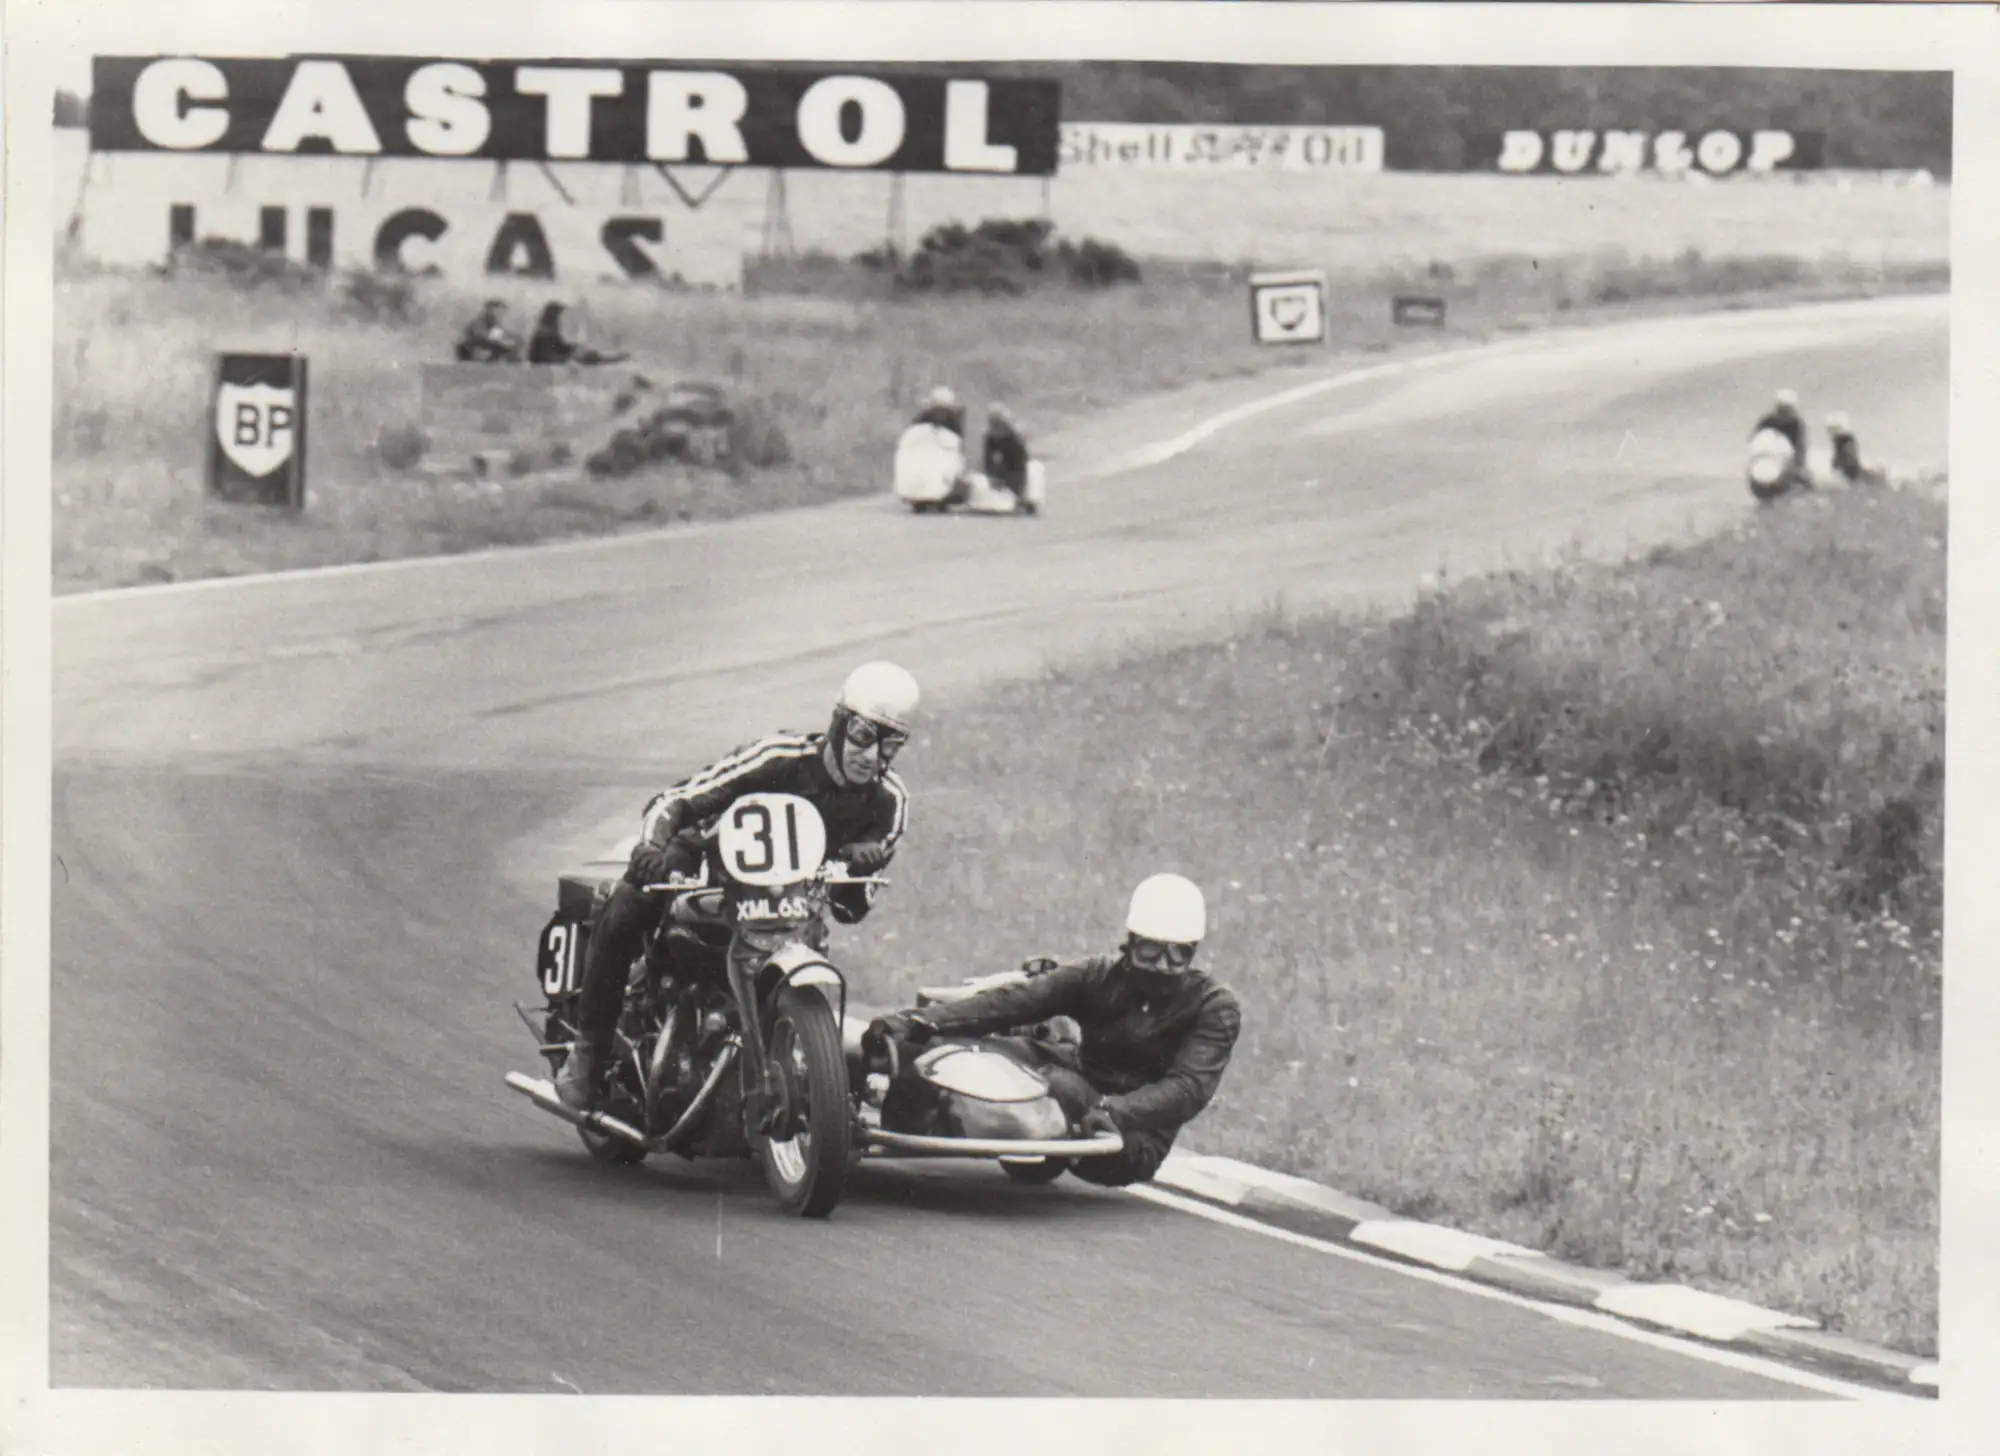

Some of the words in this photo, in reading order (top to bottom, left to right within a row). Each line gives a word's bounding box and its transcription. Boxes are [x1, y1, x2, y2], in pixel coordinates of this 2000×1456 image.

[133, 58, 1018, 172] CASTROL
[1302, 132, 1365, 166] Oil
[1498, 129, 1795, 174] DUNLOP
[234, 403, 294, 448] BP
[733, 802, 800, 873] 31
[736, 898, 778, 921] XML
[544, 922, 578, 994] 31
